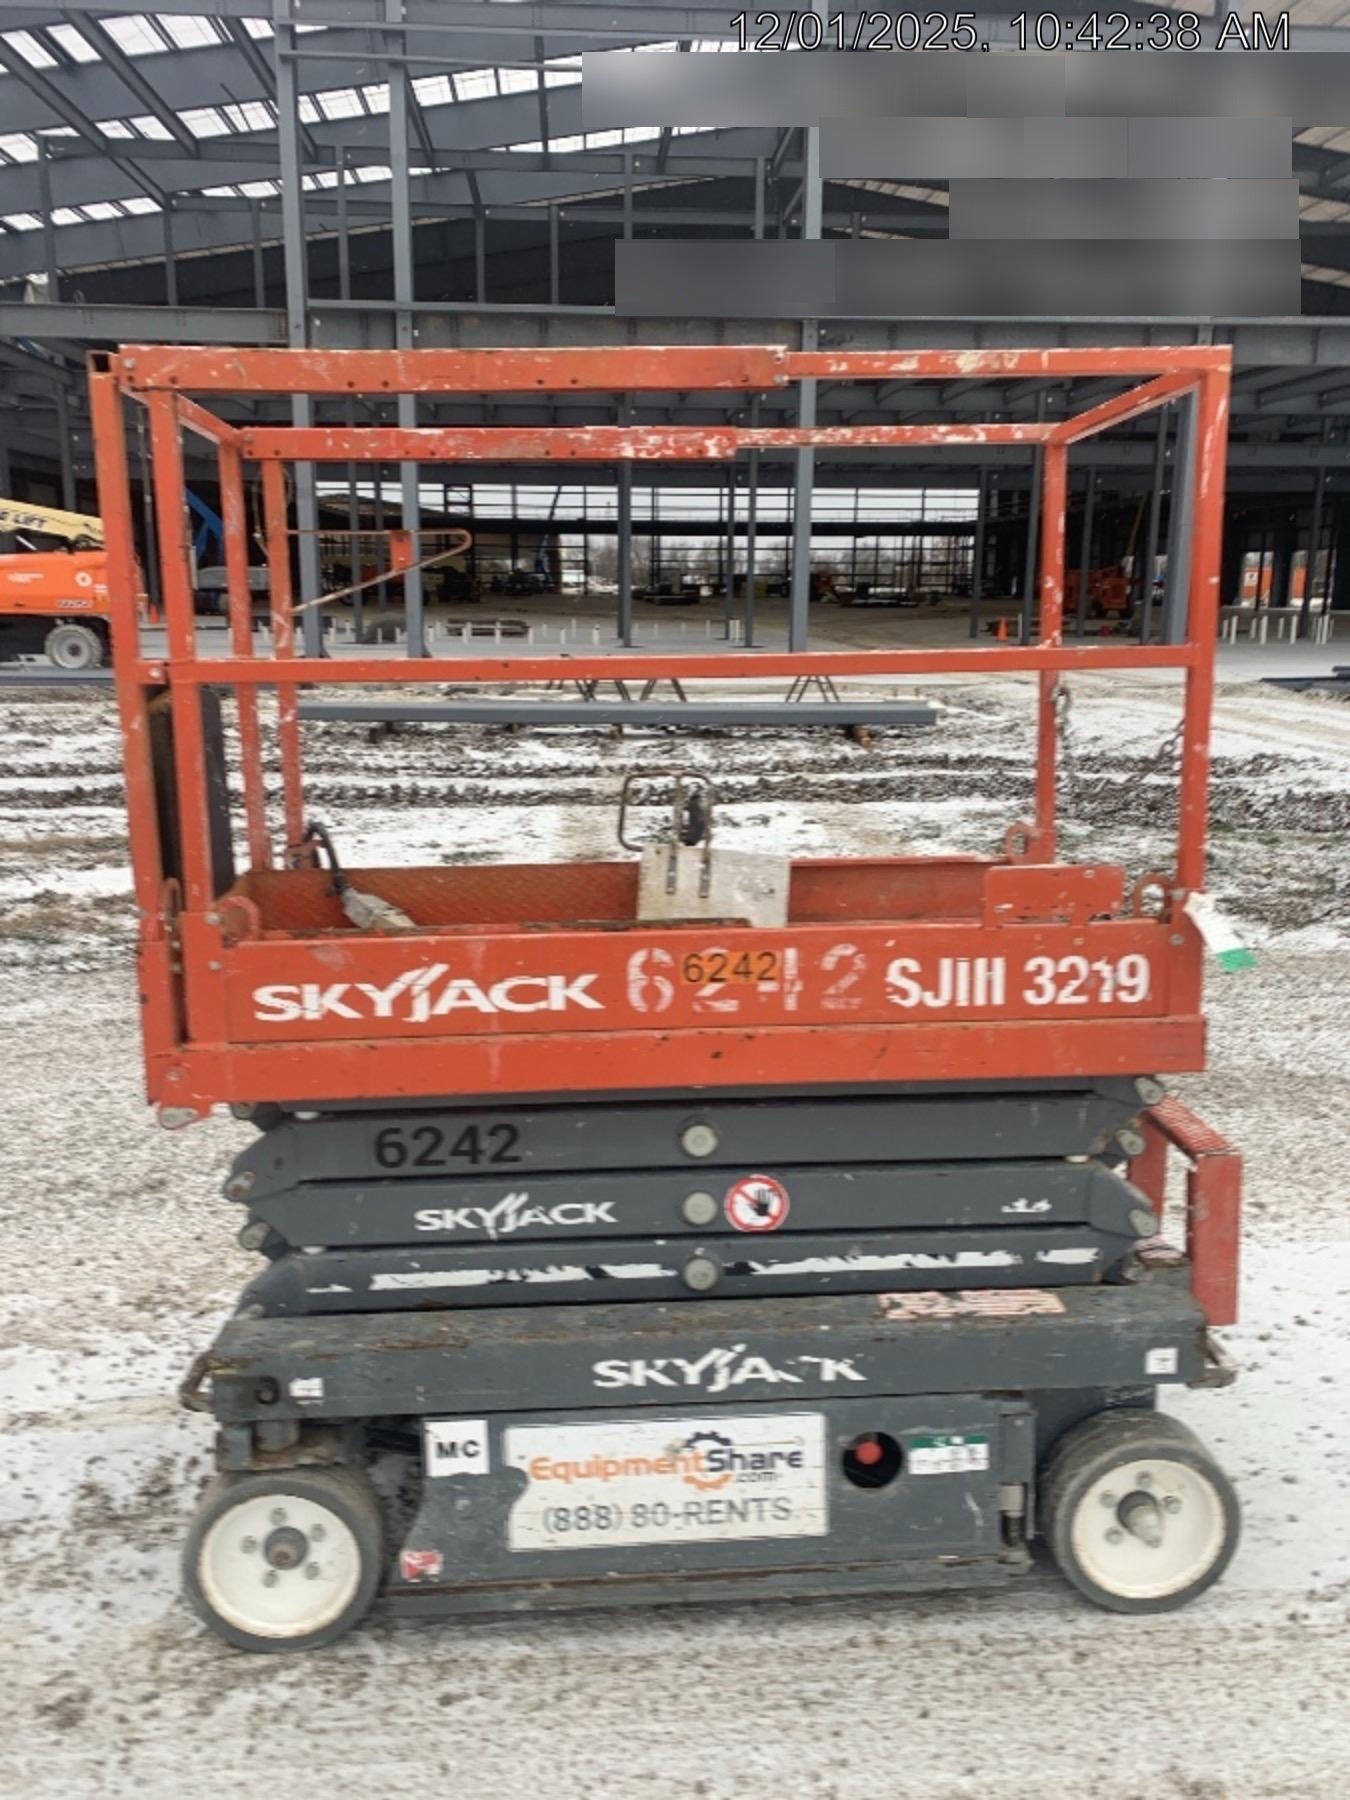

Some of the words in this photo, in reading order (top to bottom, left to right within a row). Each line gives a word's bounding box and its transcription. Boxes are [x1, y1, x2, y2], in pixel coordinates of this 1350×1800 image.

[682, 951, 778, 983] 6242
[1022, 953, 1151, 1006] 3219
[251, 962, 606, 1023] SKYJACK
[374, 1123, 522, 1168] 6242
[413, 1192, 620, 1240] SKYJACK
[528, 1448, 805, 1484] EquipmentShare
[543, 1502, 623, 1533] (888)
[630, 1496, 793, 1528] 80-RENTS
